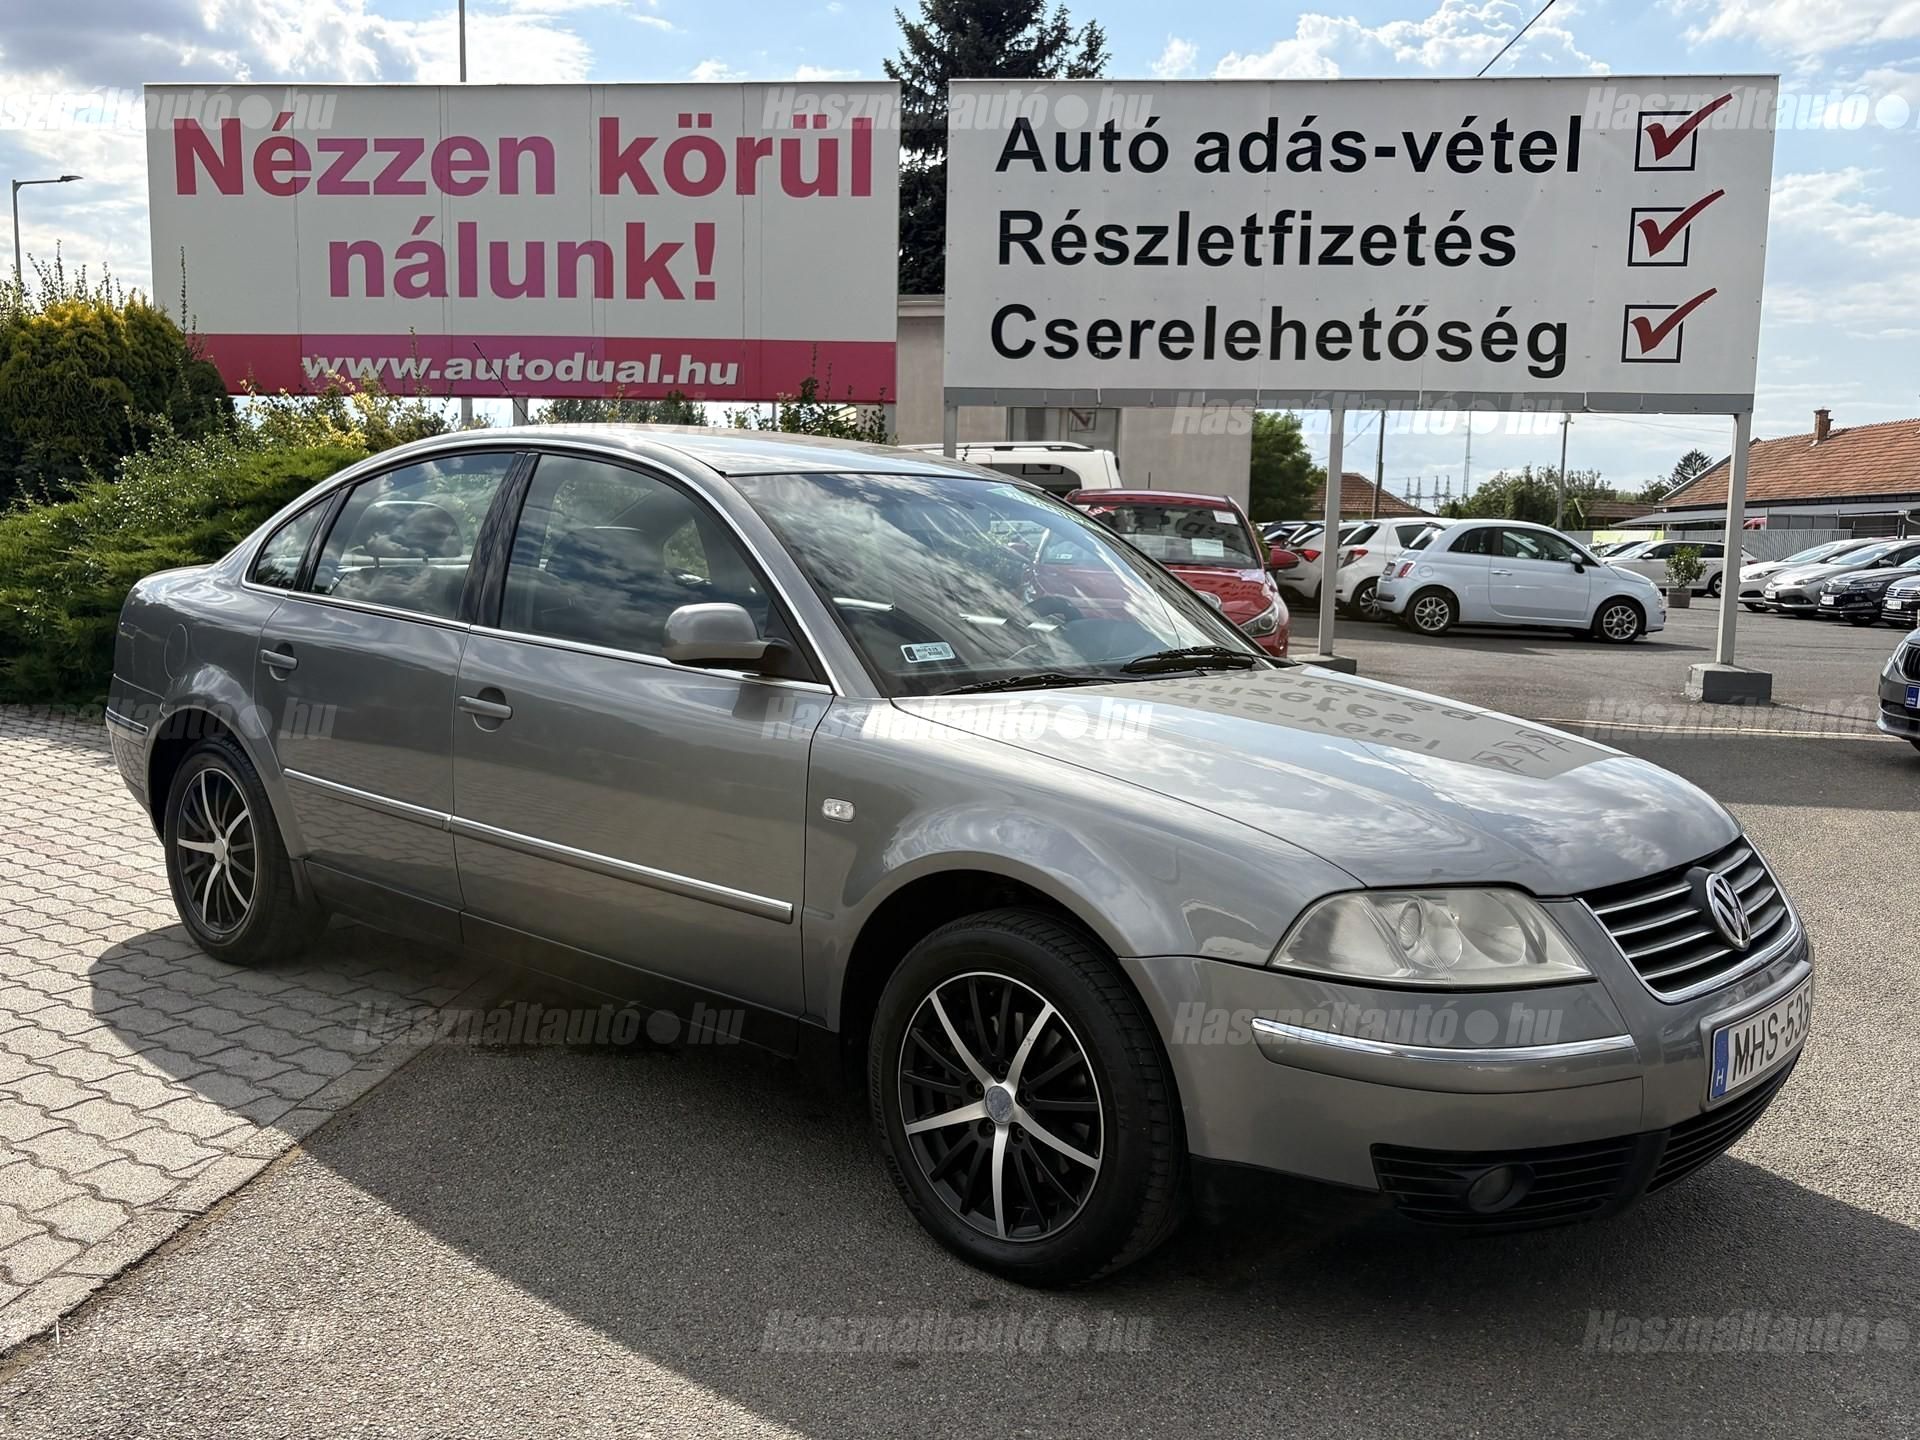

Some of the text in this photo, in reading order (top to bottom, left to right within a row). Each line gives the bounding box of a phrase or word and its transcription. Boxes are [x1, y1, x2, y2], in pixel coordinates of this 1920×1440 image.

[174, 112, 873, 197] Nézzen körül
[995, 115, 1582, 173] Autó adás-vétel
[329, 215, 716, 300] nálunk!
[999, 208, 1516, 267] Részletfizetés
[301, 352, 739, 387] www.autodual.hu
[991, 303, 1568, 379] Cserelehetőség
[1732, 985, 1811, 1082] MHS-535
[1716, 1068, 1725, 1087] H
